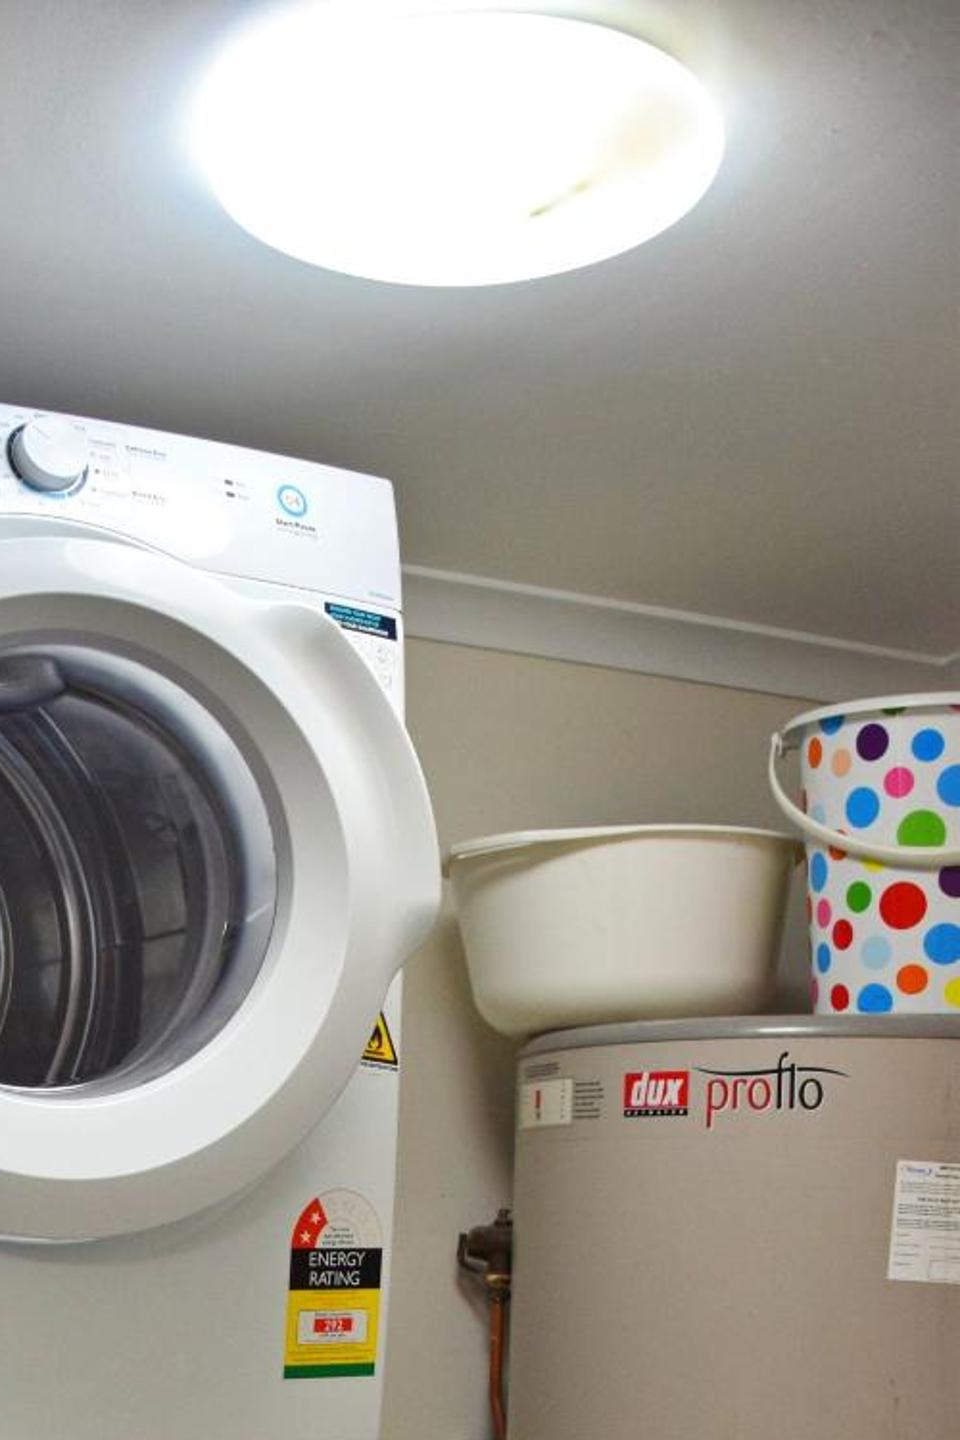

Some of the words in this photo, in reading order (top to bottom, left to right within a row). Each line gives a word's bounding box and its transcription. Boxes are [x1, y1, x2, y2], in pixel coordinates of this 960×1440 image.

[630, 1071, 684, 1107] dux
[705, 1051, 824, 1129] proflo
[308, 1251, 366, 1266] ENERGY
[308, 1270, 360, 1286] RATING
